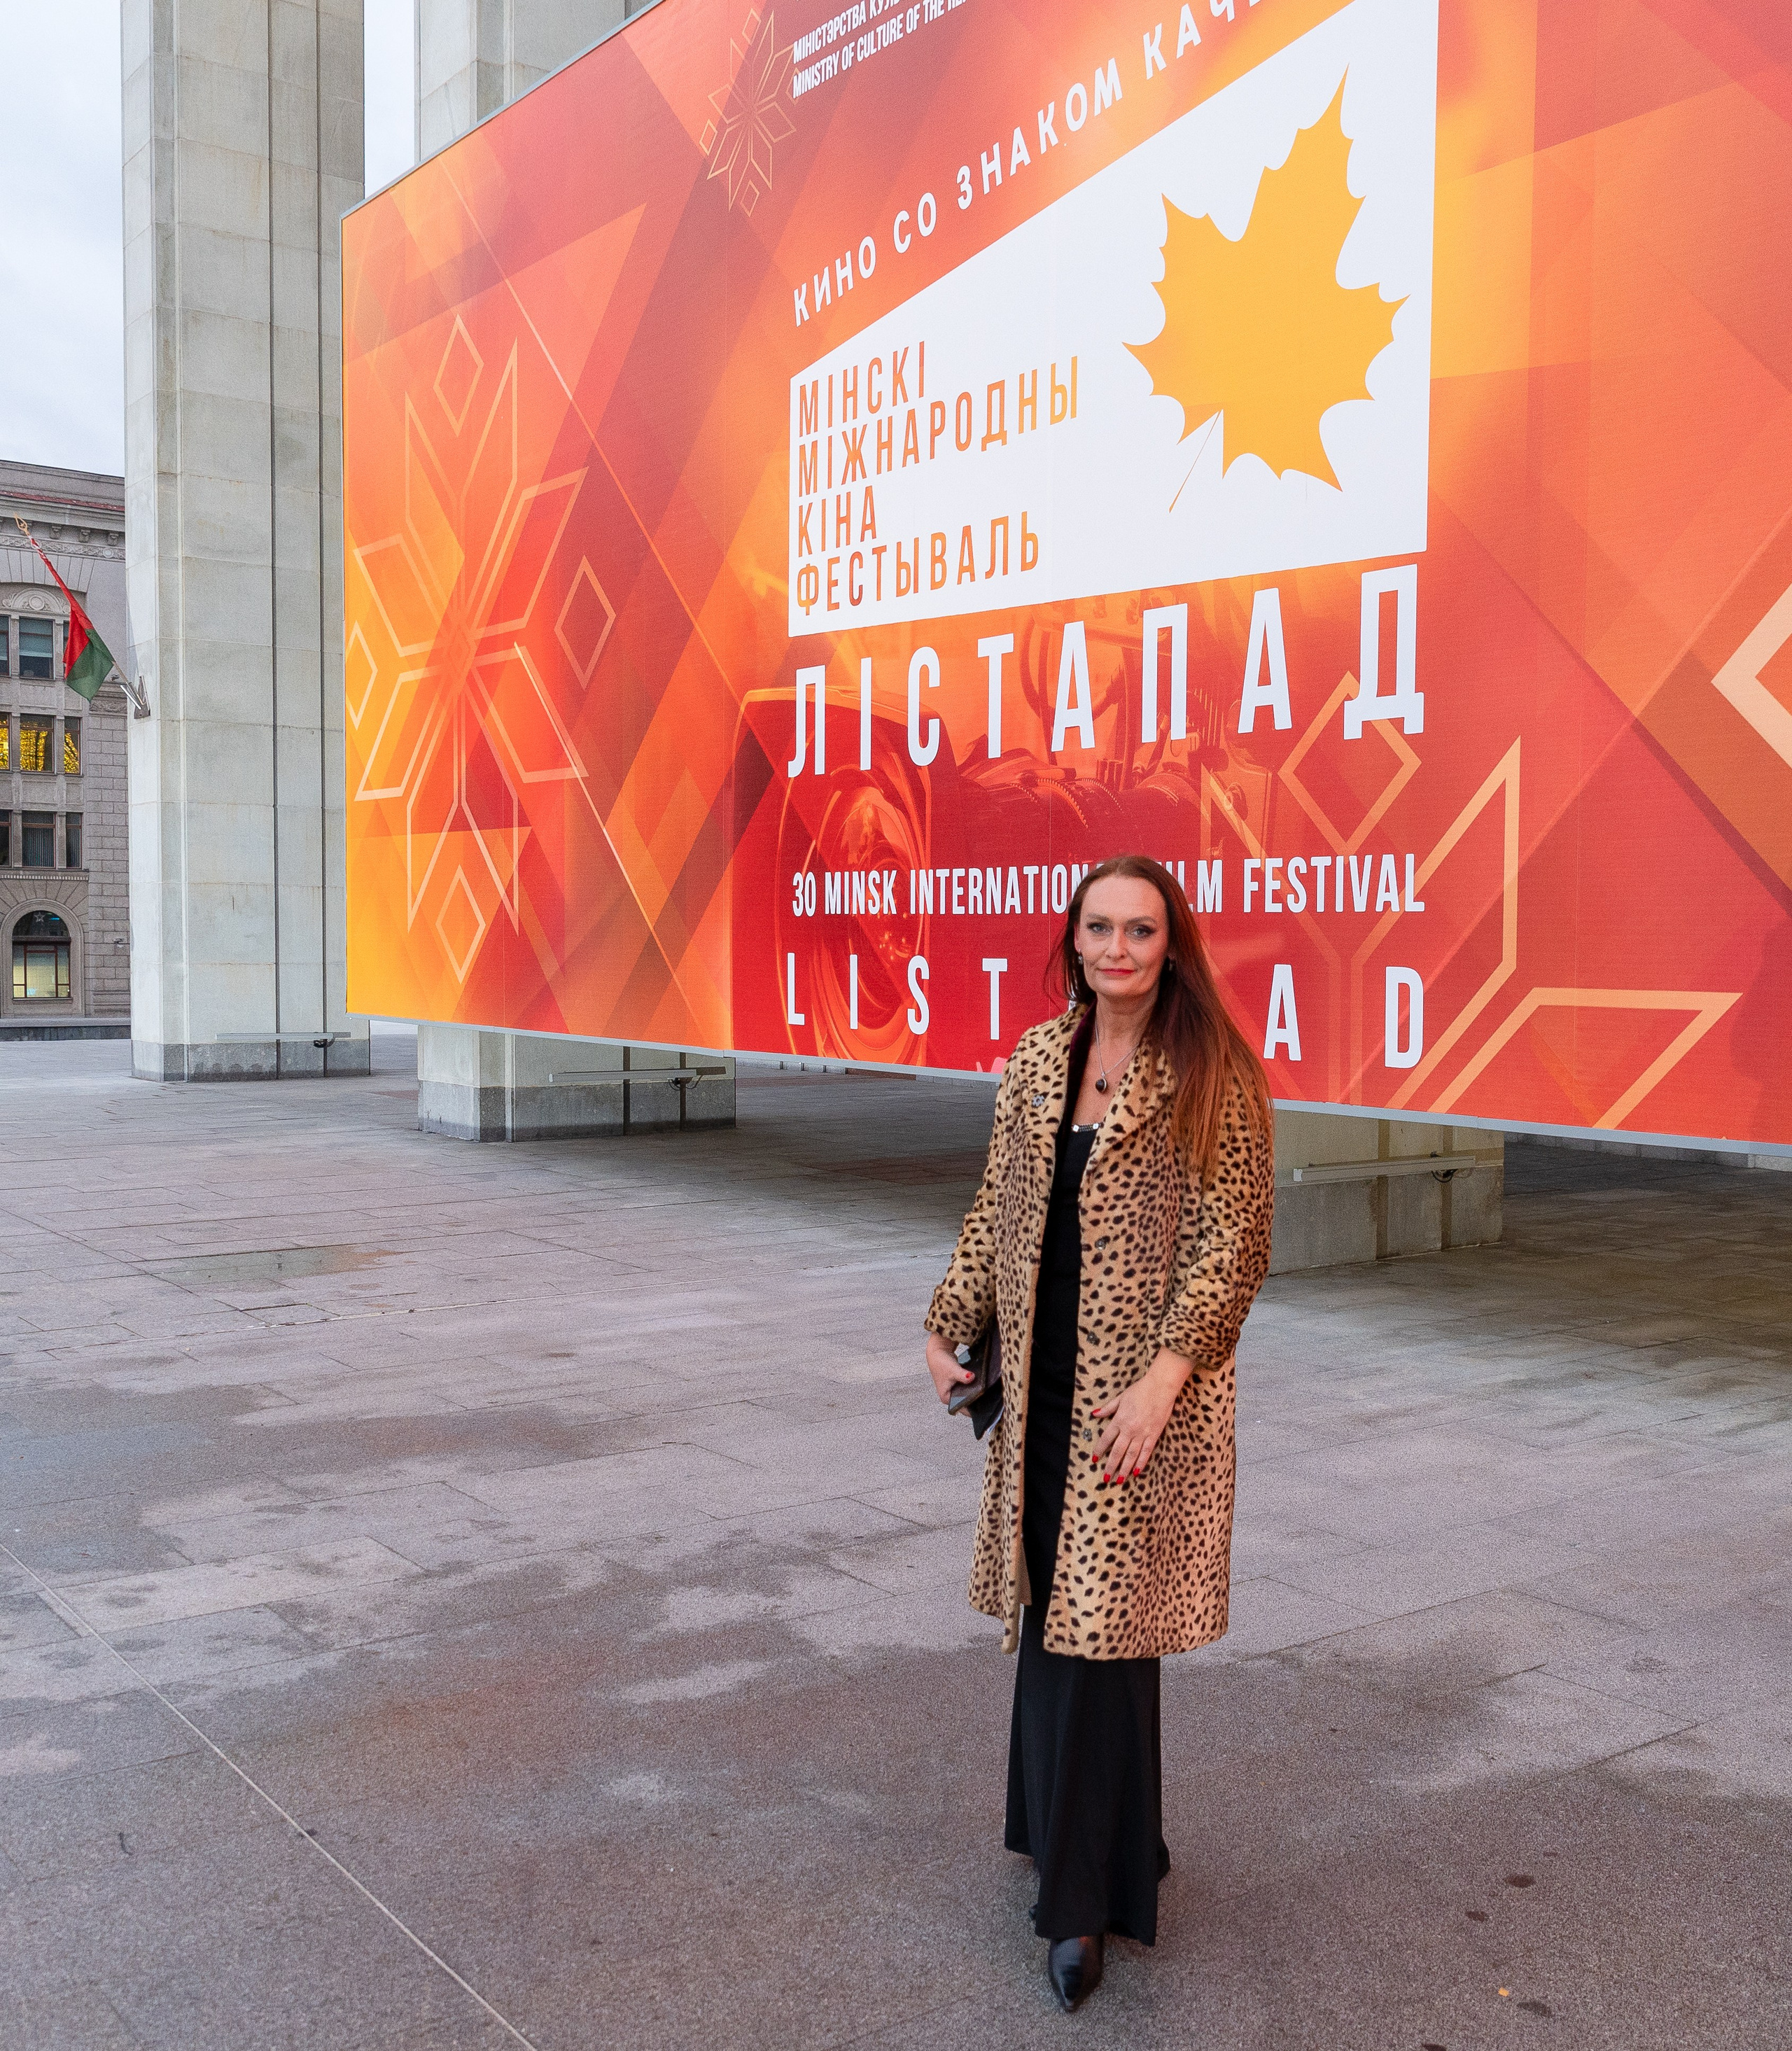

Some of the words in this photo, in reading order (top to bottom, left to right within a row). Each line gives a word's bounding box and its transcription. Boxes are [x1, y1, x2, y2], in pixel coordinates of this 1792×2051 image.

[793, 0, 867, 64] МІНІСТЭРСТВА
[793, 50, 839, 99] MINISTRY
[841, 41, 855, 71] OF
[857, 13, 904, 62] CULTURE
[906, 3, 920, 34] OF
[923, 0, 944, 24] THE
[794, 236, 876, 328] КИНО
[893, 192, 937, 253] СО
[956, 57, 1123, 210] ЗНАКОМ
[1142, 0, 1260, 80] КАЧ
[799, 341, 925, 438] МІНСКІ
[799, 356, 1078, 498] МІЖНАРОДНЫ
[797, 511, 1039, 616] ФЕСТЫВАЛЬ
[798, 485, 876, 557] КІНА
[788, 564, 1424, 778] ЛІСТАПАД
[792, 872, 816, 916] 30
[825, 870, 897, 915] MINSK
[910, 863, 1105, 915] INTERNATION
[1243, 853, 1425, 913] FESTIVAL
[787, 953, 1424, 1068] LISTAD
